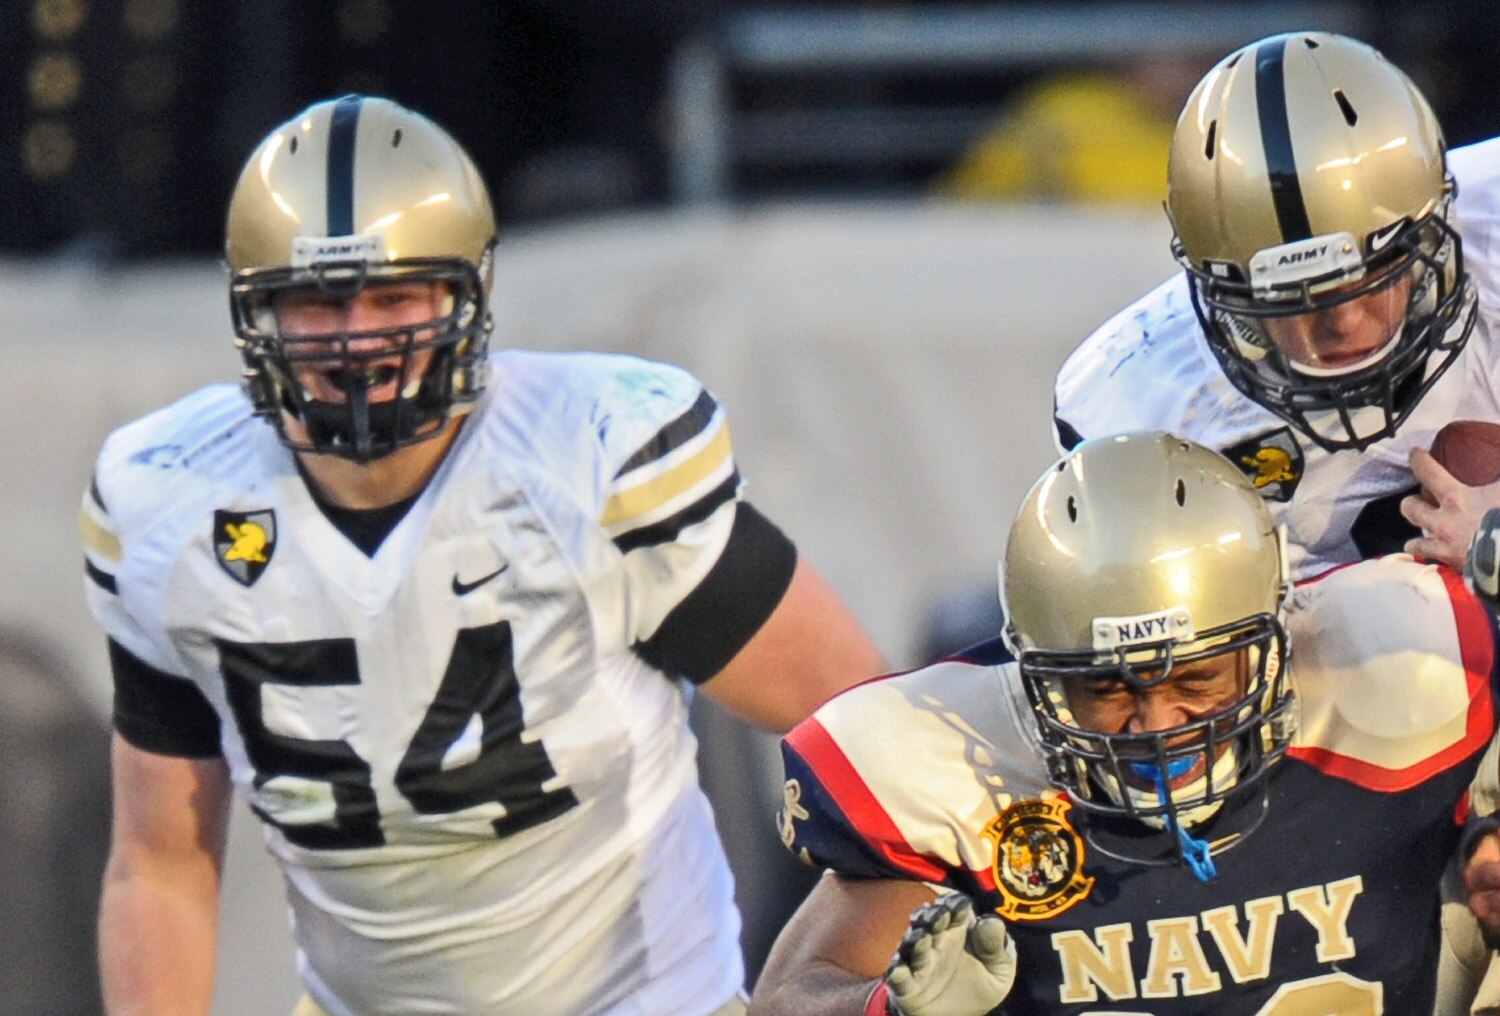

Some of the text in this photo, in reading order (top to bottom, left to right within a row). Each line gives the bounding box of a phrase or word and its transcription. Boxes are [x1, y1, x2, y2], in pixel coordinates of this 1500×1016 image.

[317, 245, 366, 257] ARMY
[1277, 245, 1330, 266] ARMY
[1117, 616, 1168, 643] NAVY
[215, 620, 580, 848] 54
[1051, 875, 1364, 1003] NAVY
